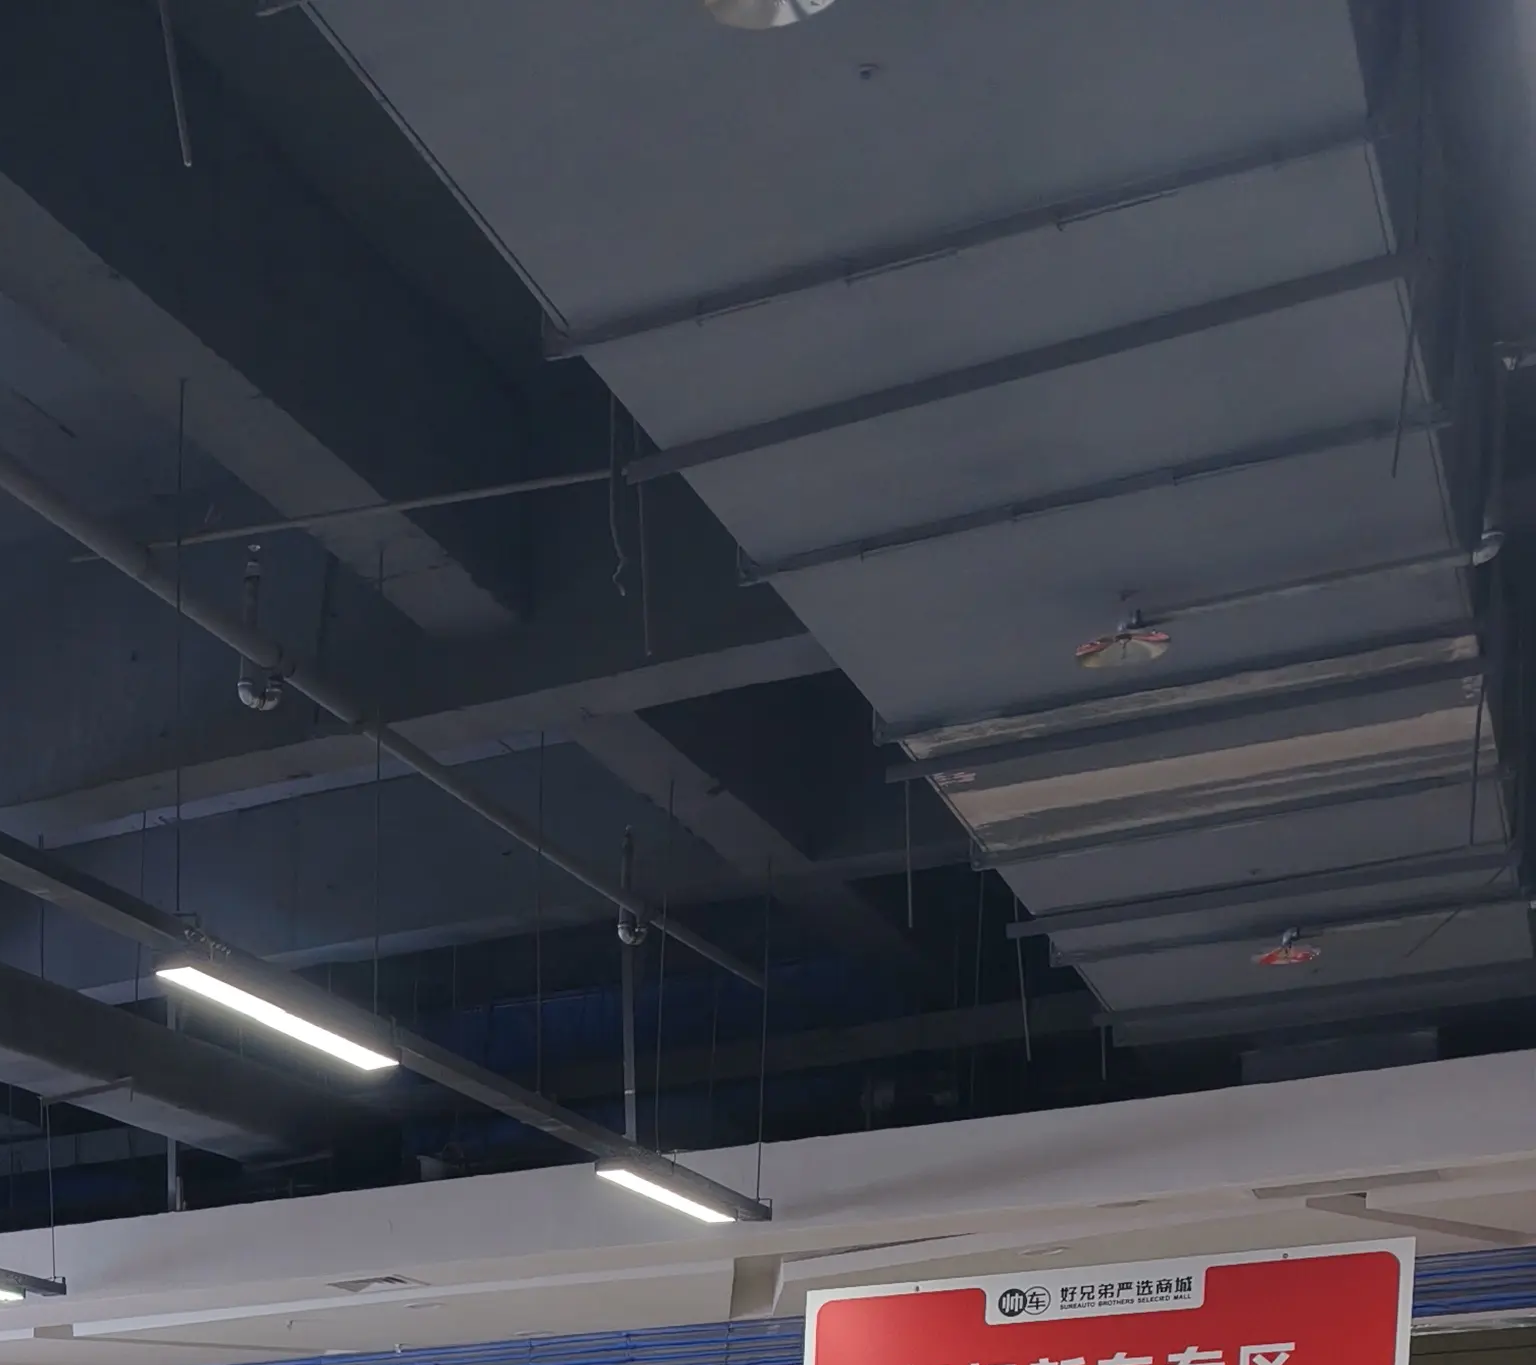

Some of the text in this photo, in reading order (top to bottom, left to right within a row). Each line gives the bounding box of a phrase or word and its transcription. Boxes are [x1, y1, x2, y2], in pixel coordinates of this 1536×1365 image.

[1060, 1276, 1193, 1303] 好兄弟严选商城
